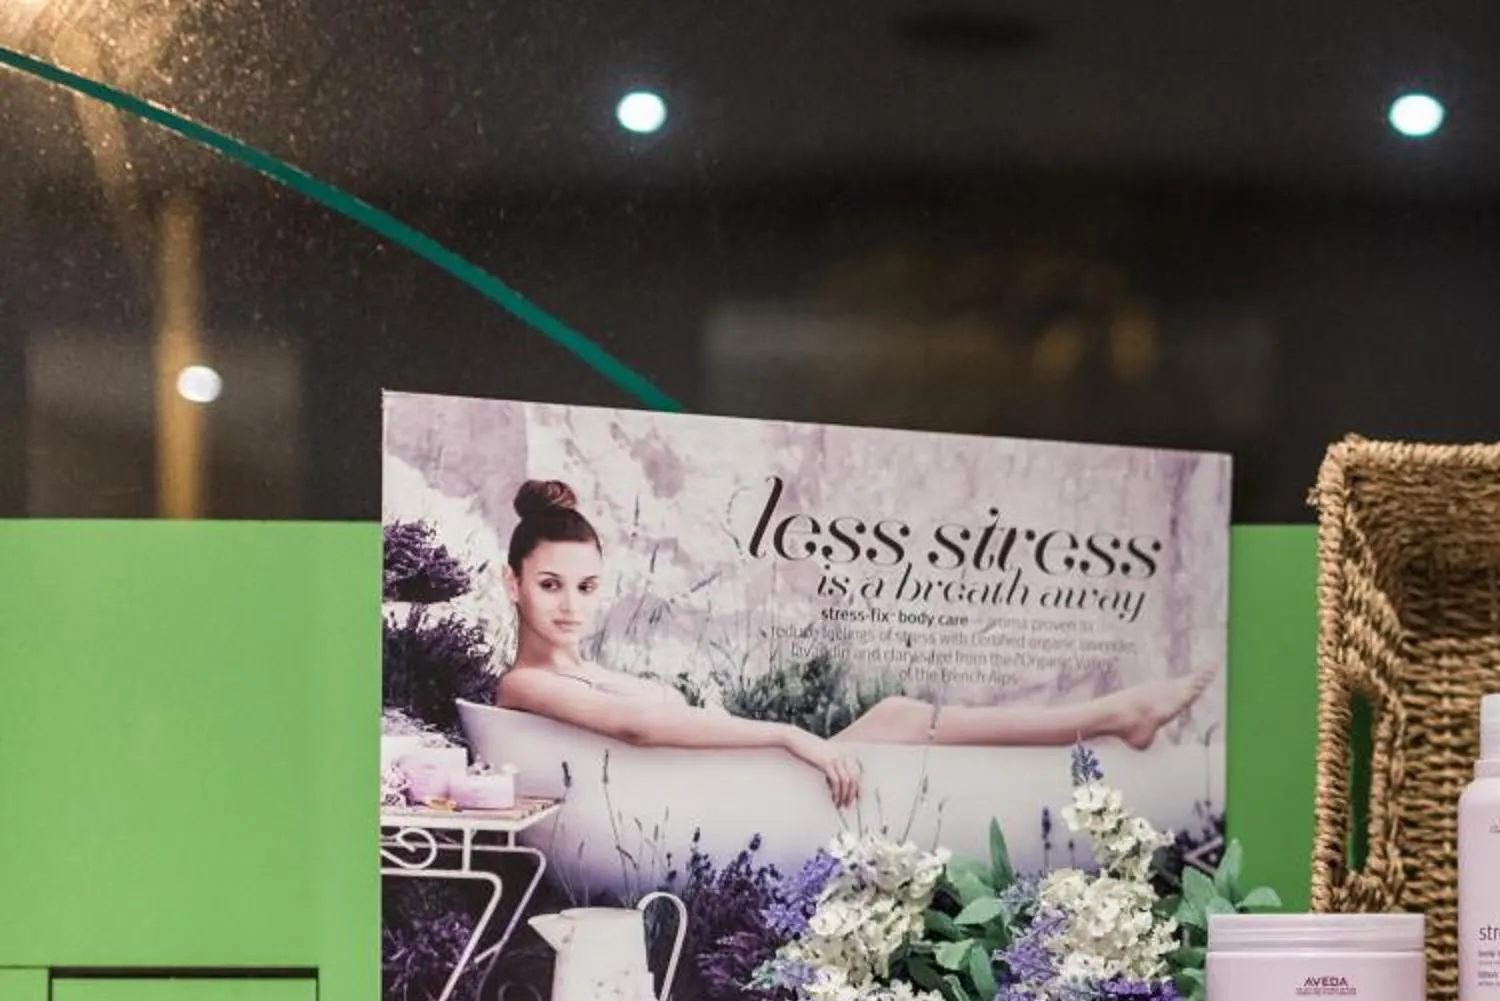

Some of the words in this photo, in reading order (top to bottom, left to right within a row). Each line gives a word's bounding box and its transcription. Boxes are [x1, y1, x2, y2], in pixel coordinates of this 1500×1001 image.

[748, 475, 911, 566] less
[928, 506, 1163, 580] stress
[817, 563, 850, 597] is
[859, 579, 884, 601] a
[896, 561, 1030, 606] breath
[1039, 585, 1146, 624] away
[898, 610, 935, 627] body
[937, 615, 969, 627] care
[879, 628, 892, 642] of
[895, 630, 937, 645] stress
[940, 631, 968, 646] with
[954, 650, 987, 664] from
[915, 668, 939, 681] the
[1303, 976, 1349, 987] AVEDA
